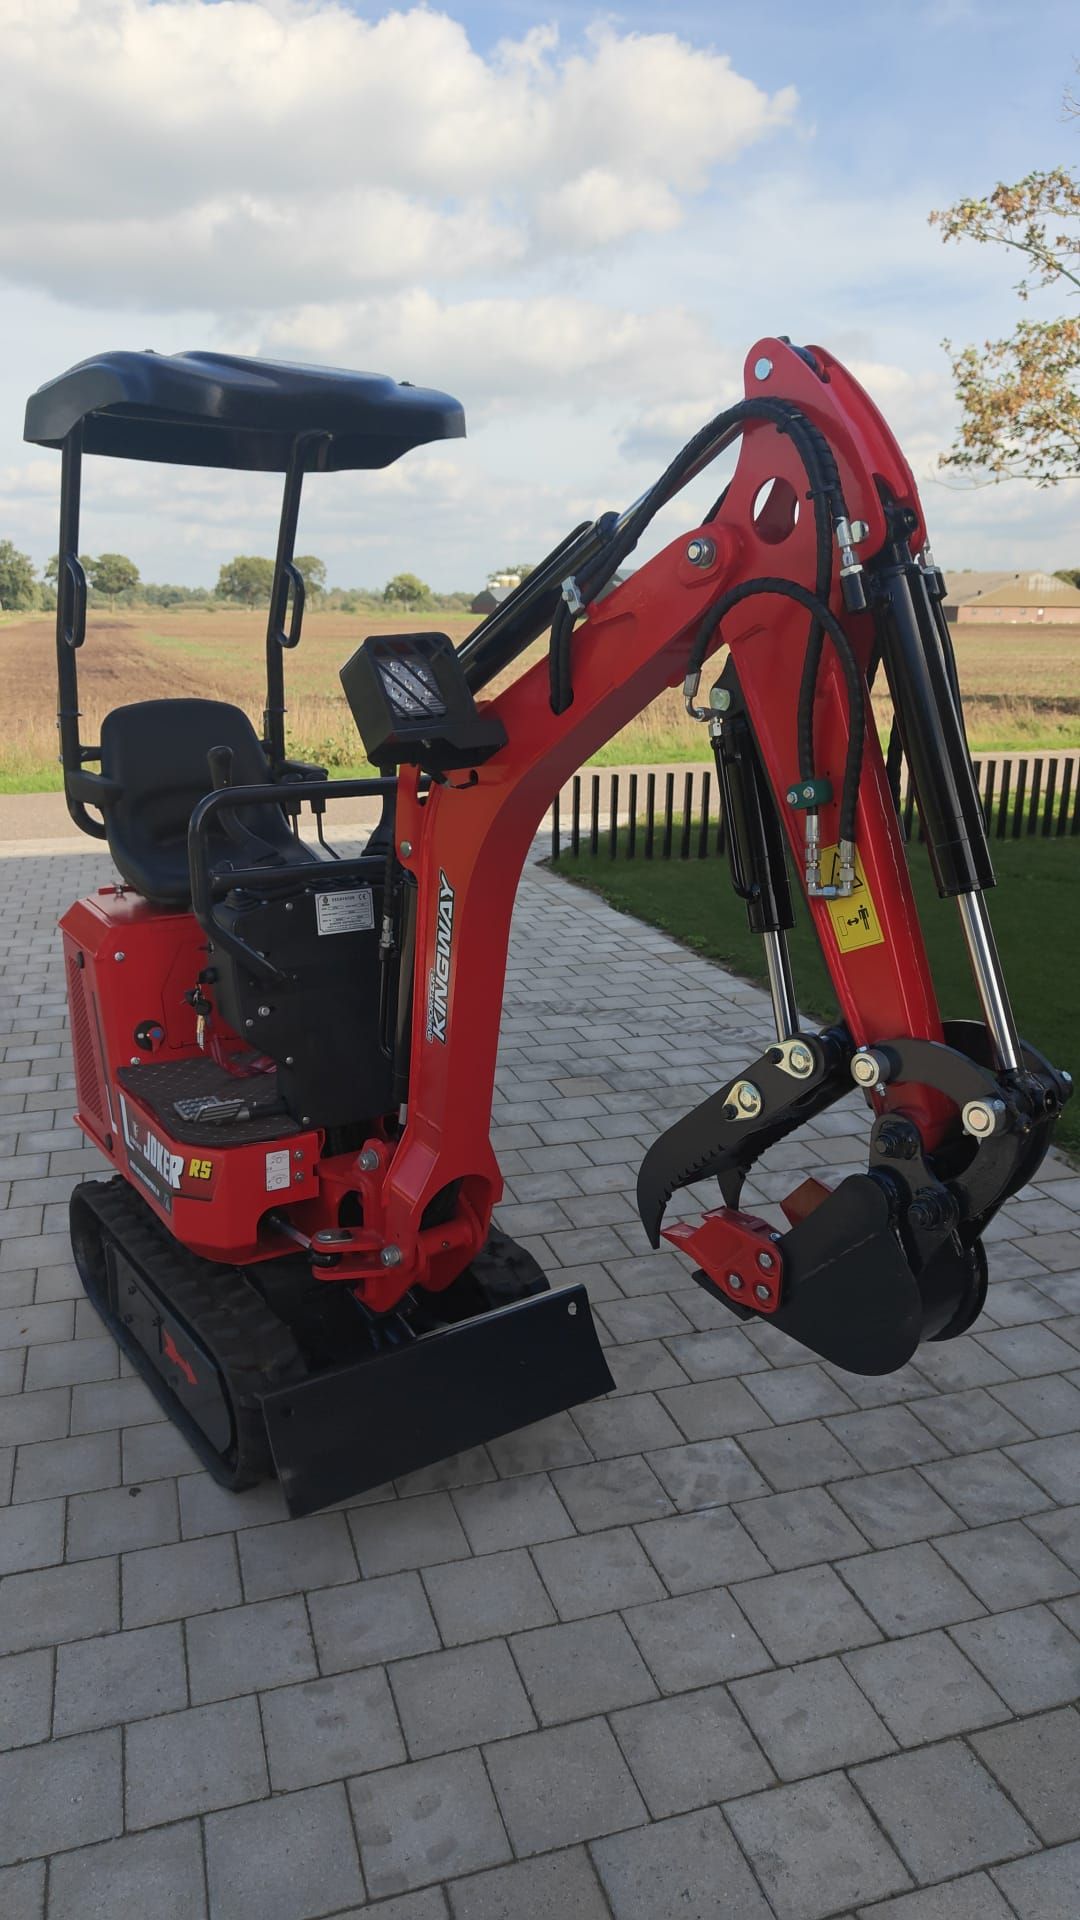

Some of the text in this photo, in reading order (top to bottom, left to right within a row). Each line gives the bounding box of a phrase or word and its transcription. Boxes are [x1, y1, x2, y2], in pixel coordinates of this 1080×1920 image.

[432, 868, 454, 1044] KINGWAY
[143, 1131, 184, 1189] JOKER
[189, 1158, 213, 1180] RS
